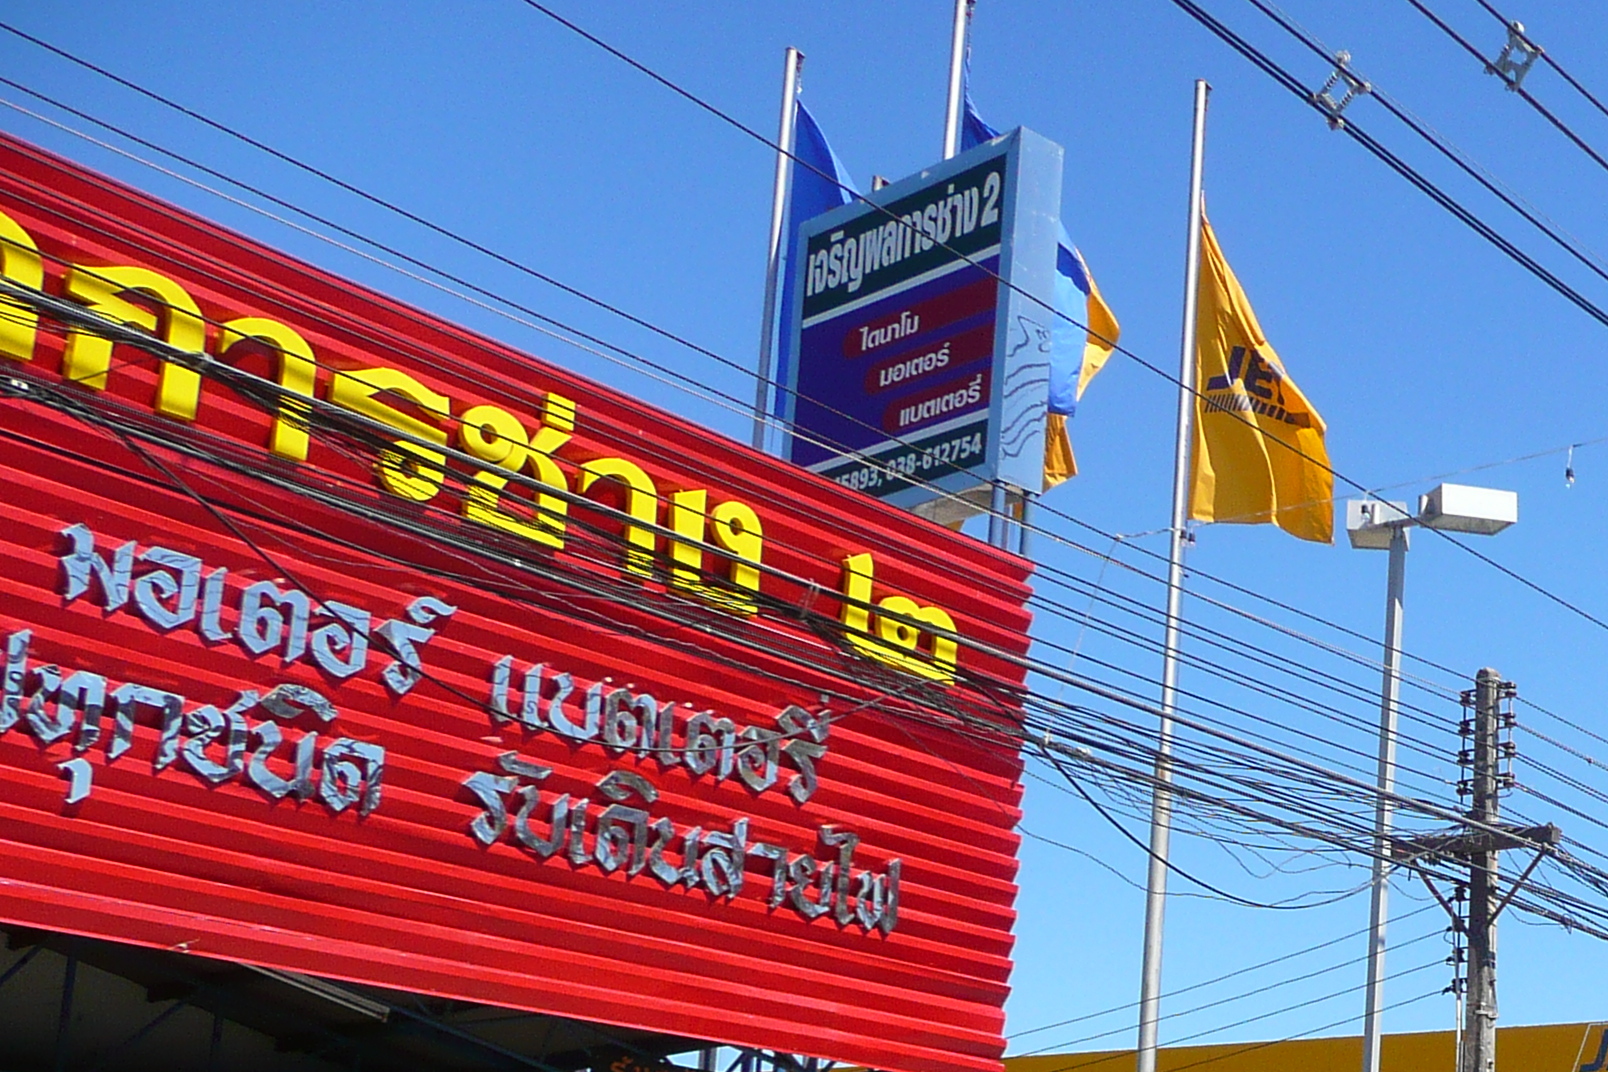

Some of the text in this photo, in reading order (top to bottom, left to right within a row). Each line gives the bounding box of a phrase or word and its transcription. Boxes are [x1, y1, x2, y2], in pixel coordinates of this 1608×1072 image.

[980, 171, 1001, 228] 2
[859, 311, 920, 351] ไดนาโม
[879, 342, 951, 388] มอเตอร์
[899, 373, 982, 428] แบตเตอรี่
[886, 432, 982, 480] 038-612754
[60, 523, 457, 694] มอเตอร์
[461, 750, 902, 934] รับเดินสายไฟ
